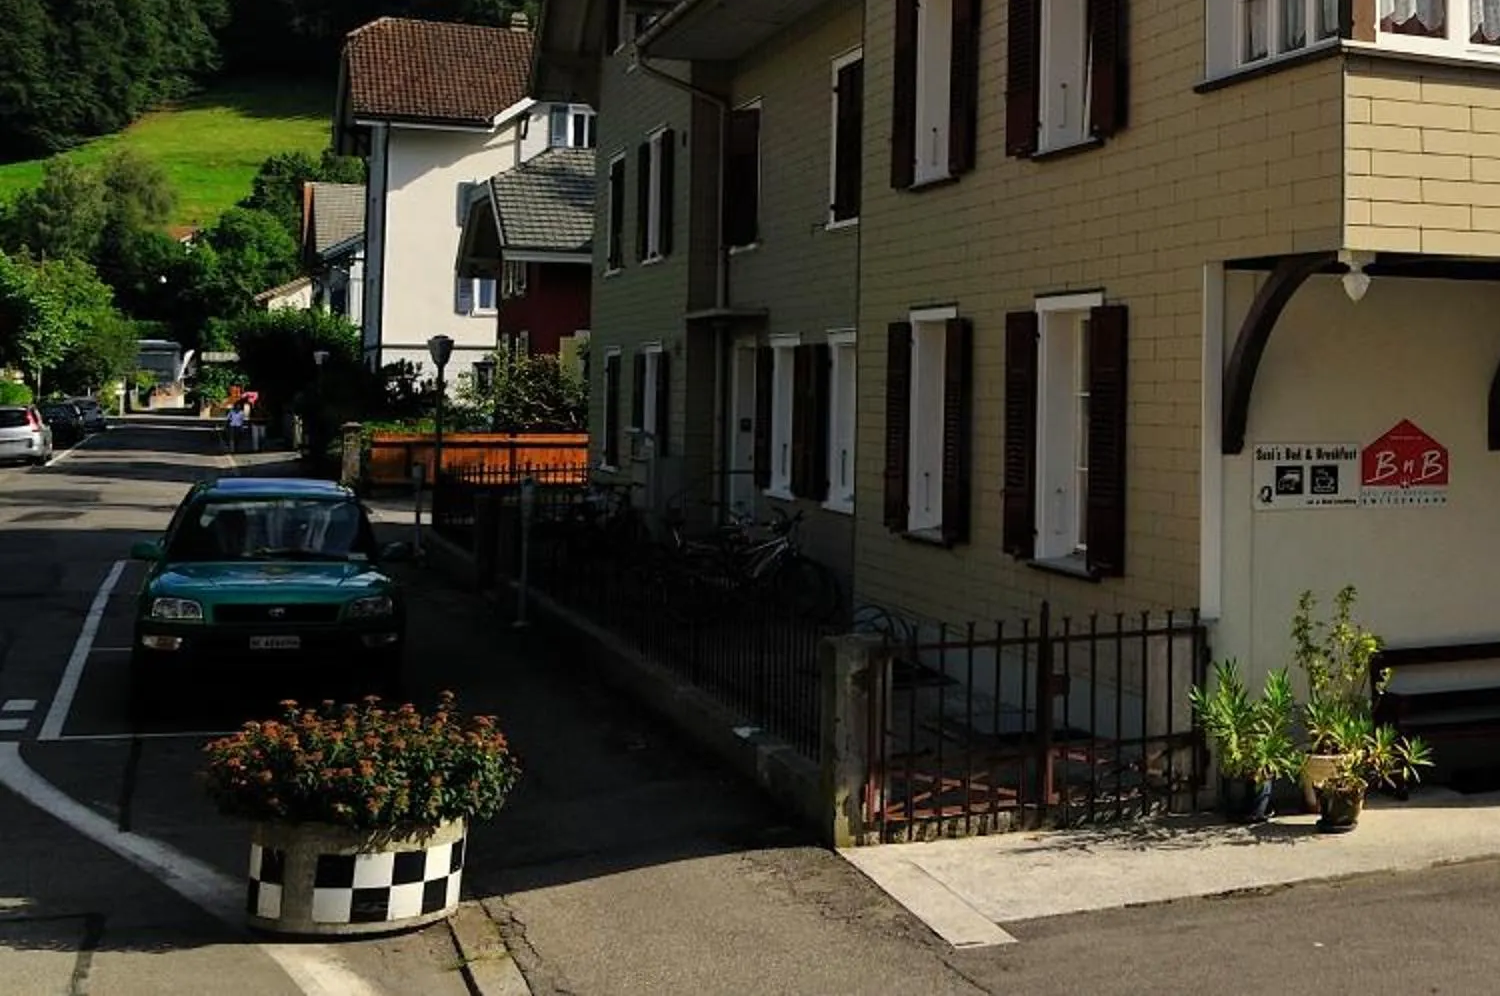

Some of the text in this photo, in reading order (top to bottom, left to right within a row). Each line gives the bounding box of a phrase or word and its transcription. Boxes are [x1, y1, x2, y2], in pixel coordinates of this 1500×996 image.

[1286, 447, 1301, 461] Bed
[1305, 448, 1312, 461] &
[1316, 446, 1357, 461] Breakfast
